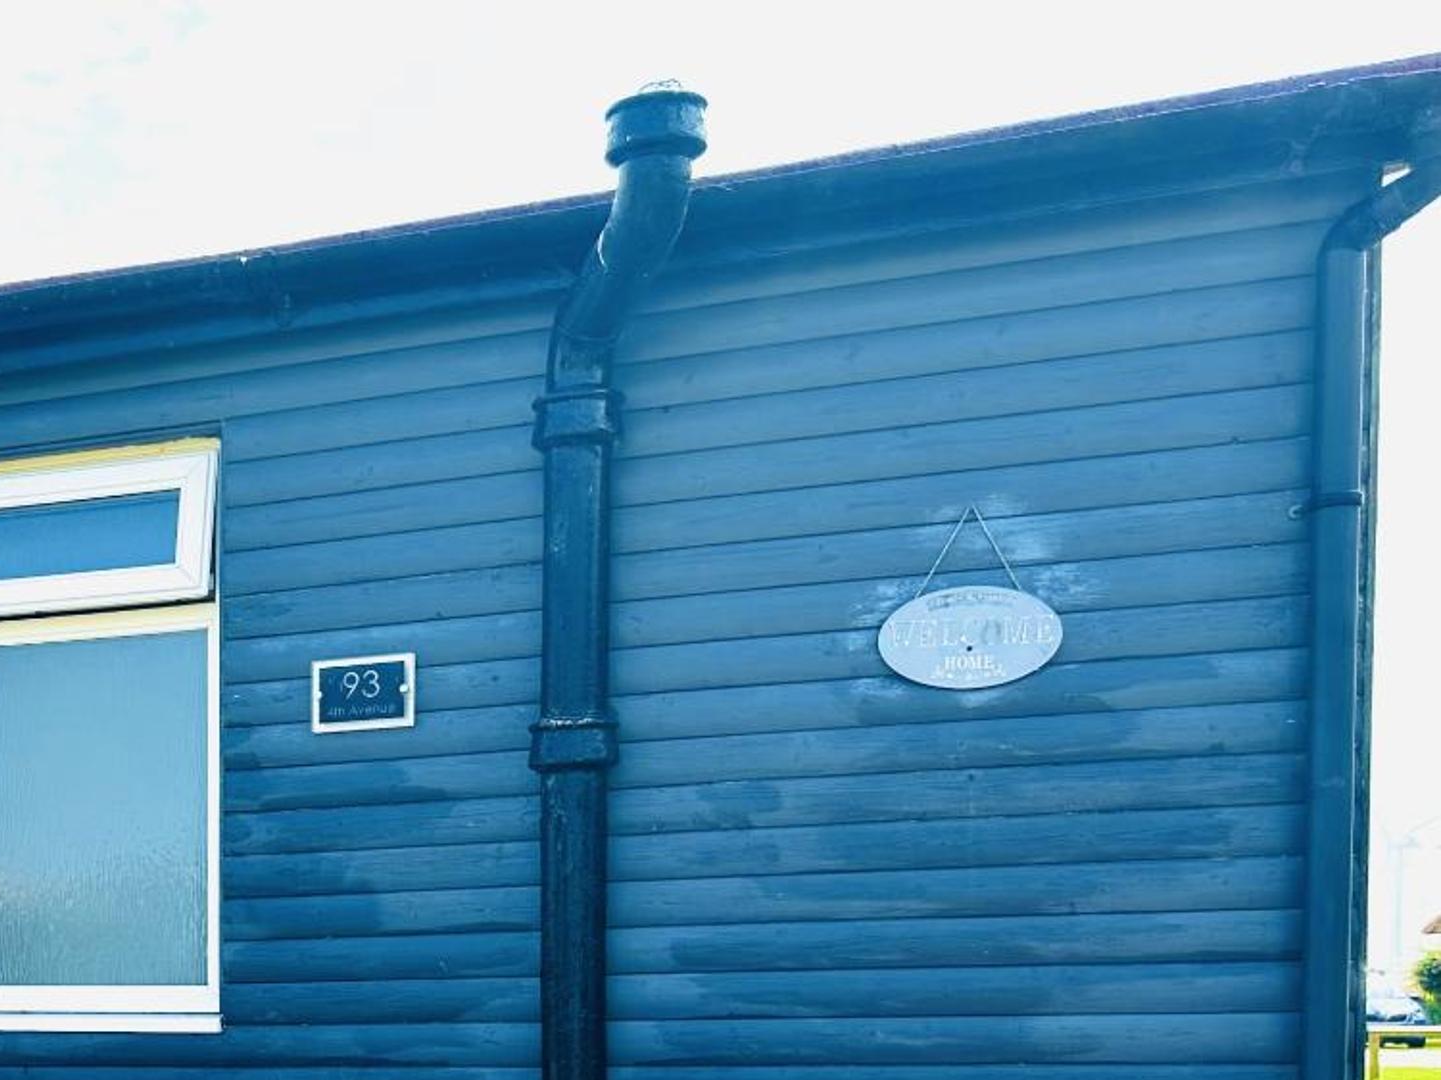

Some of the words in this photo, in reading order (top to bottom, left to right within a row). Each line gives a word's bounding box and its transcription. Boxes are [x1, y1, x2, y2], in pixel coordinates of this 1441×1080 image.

[888, 614, 1056, 647] WELCOME
[944, 655, 993, 670] HOME
[343, 670, 380, 701] 93
